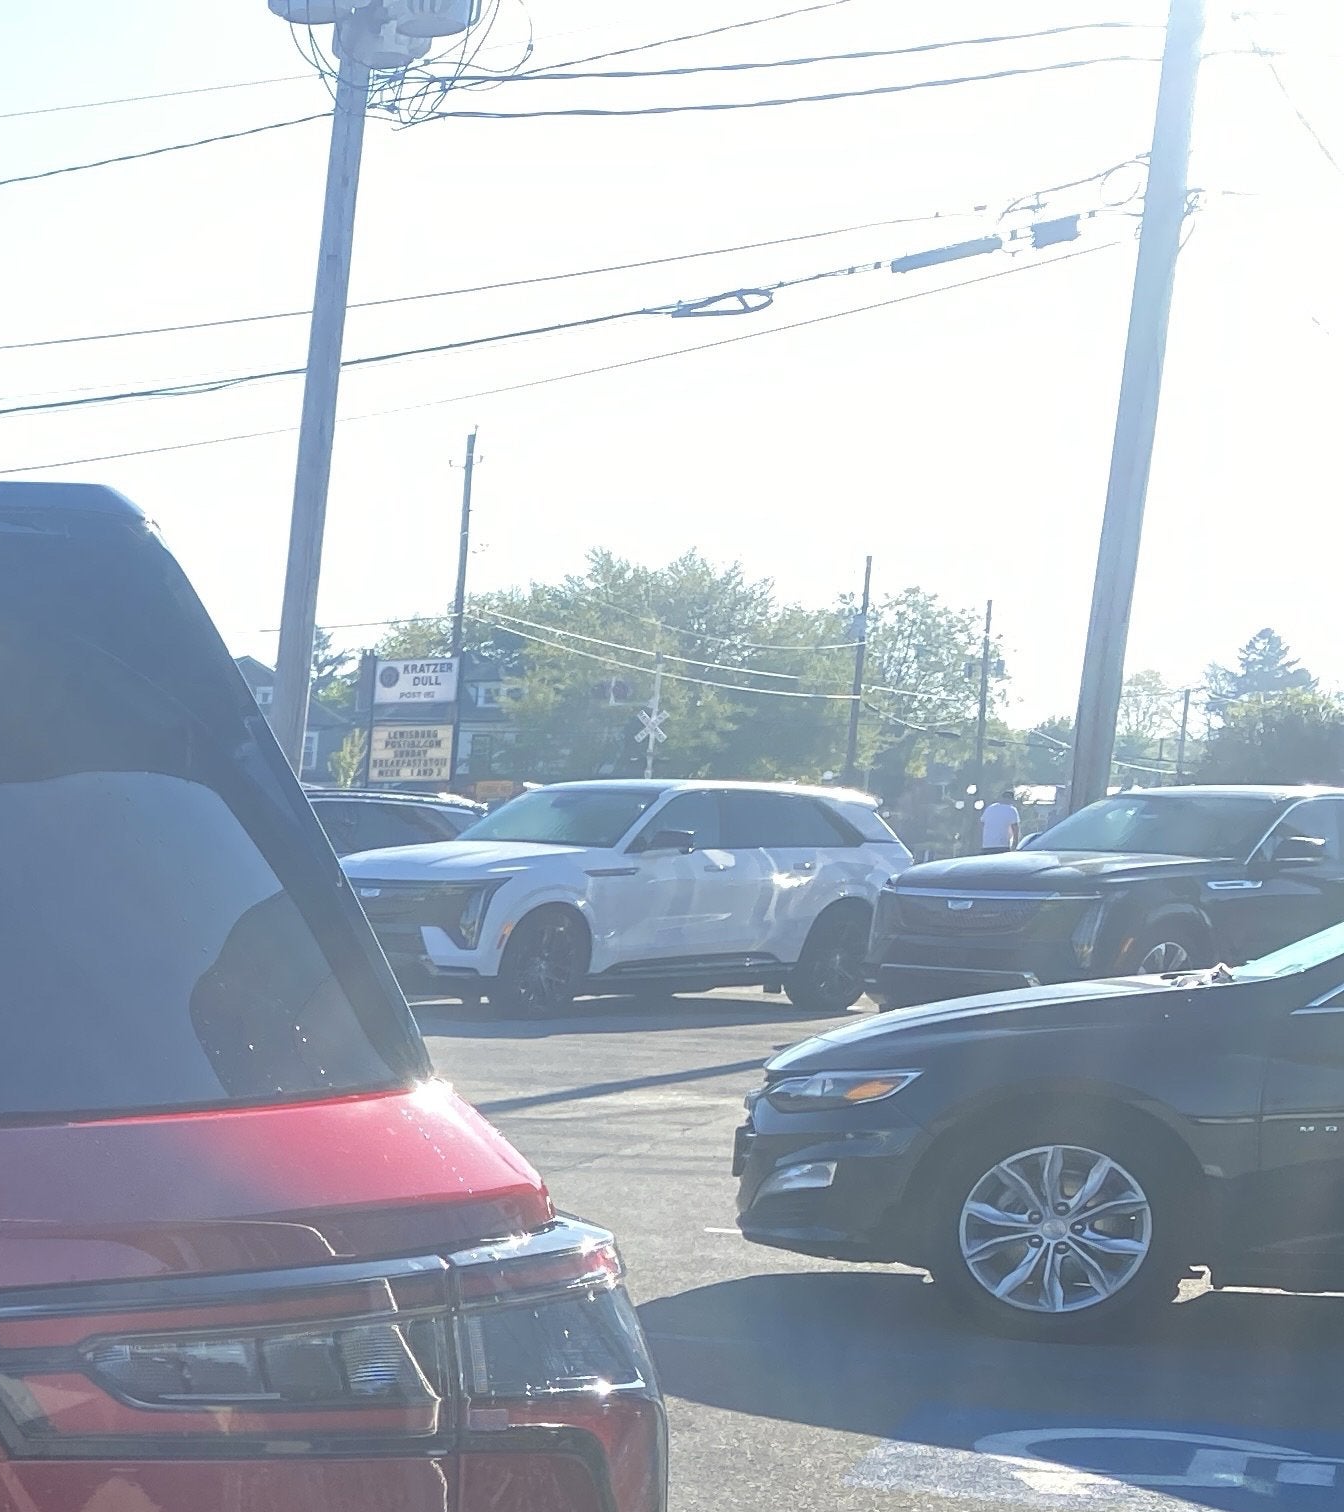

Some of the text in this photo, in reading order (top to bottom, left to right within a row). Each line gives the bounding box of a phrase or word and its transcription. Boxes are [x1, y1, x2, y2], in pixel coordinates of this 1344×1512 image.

[403, 663, 453, 674] KRATZER
[413, 676, 441, 686] DULL
[399, 691, 422, 699] POST
[388, 730, 438, 739] LEWISBURG
[394, 750, 428, 758] SUNDAY
[378, 769, 400, 777] WEEK
[416, 768, 433, 777] AND
